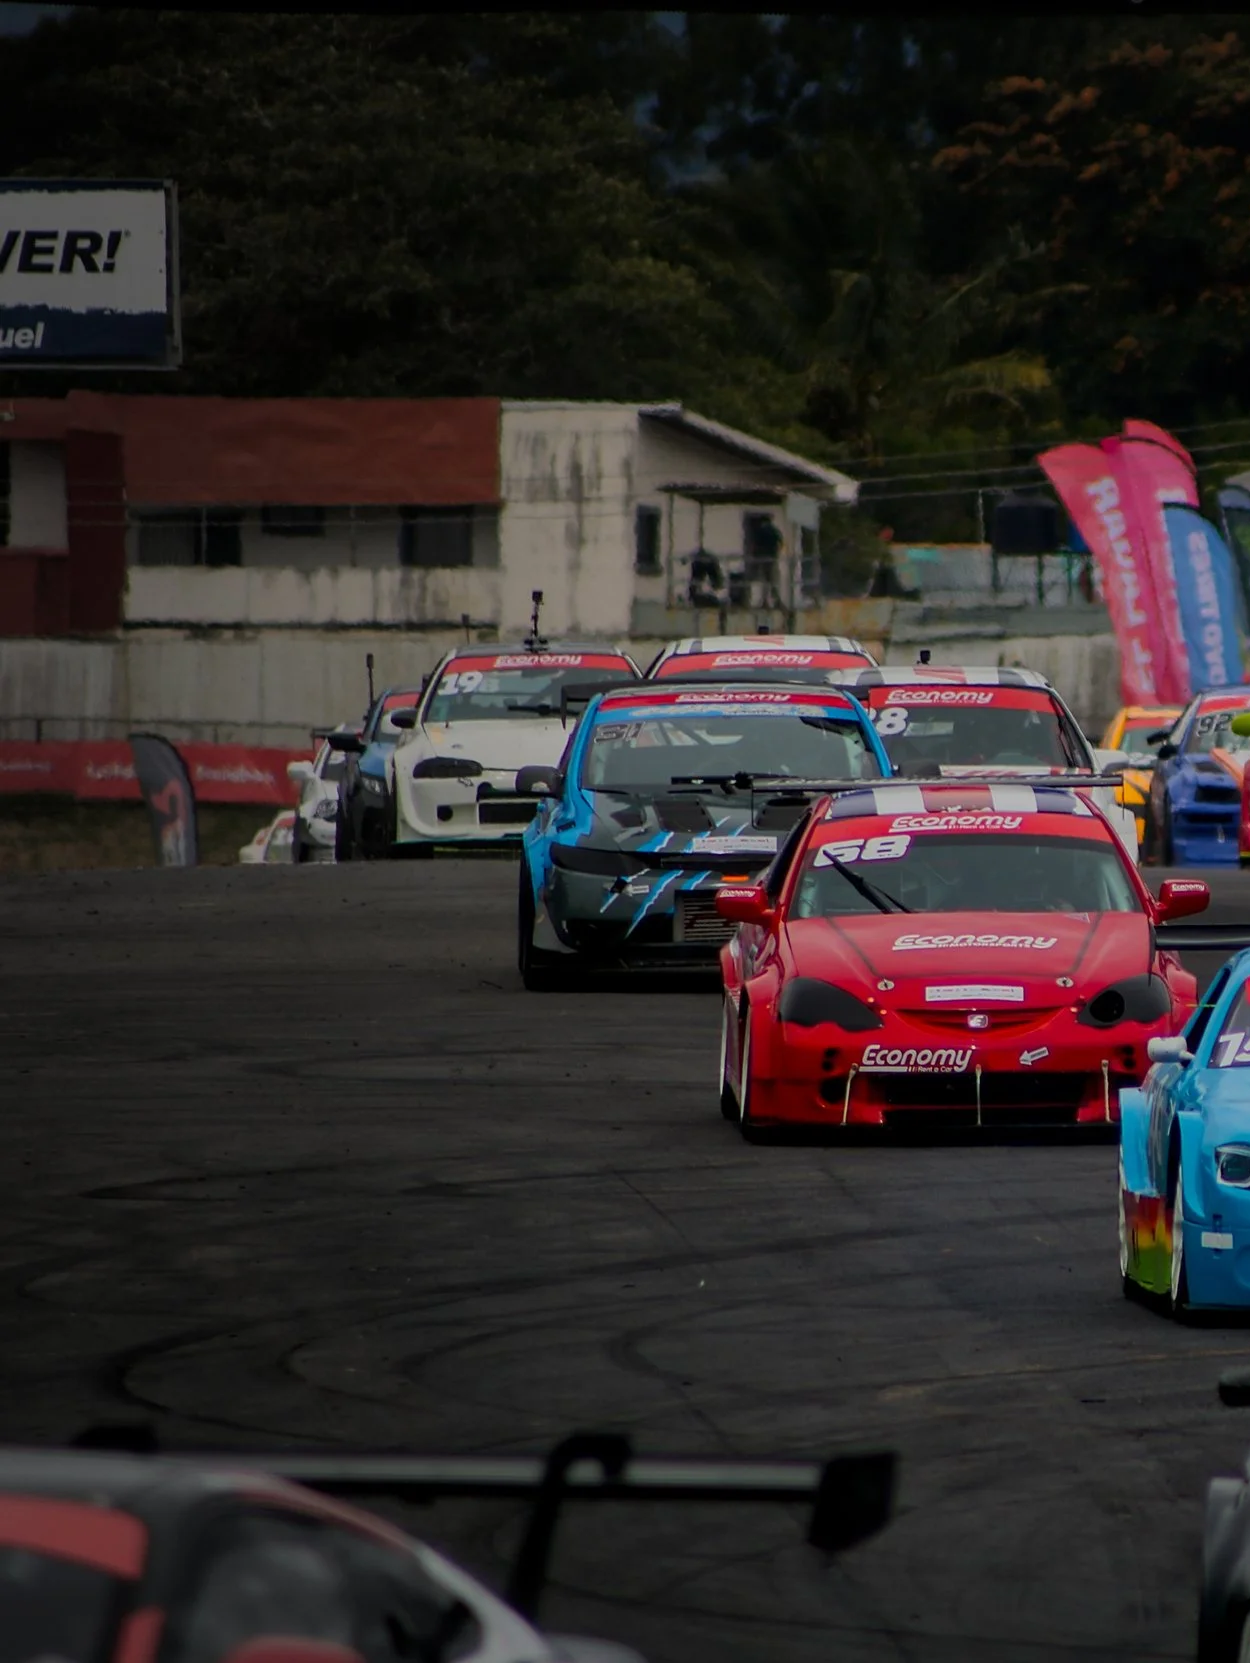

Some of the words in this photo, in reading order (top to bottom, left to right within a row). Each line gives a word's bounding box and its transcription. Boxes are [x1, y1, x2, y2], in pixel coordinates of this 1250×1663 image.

[494, 654, 583, 668] Economy
[712, 653, 814, 667] Economy
[437, 671, 484, 695] 19
[675, 692, 792, 703] Economy
[885, 689, 995, 704] Economy
[867, 706, 909, 736] 8
[888, 815, 1023, 833] Economy
[892, 934, 1058, 951] Economy
[859, 1043, 973, 1073] Economy
